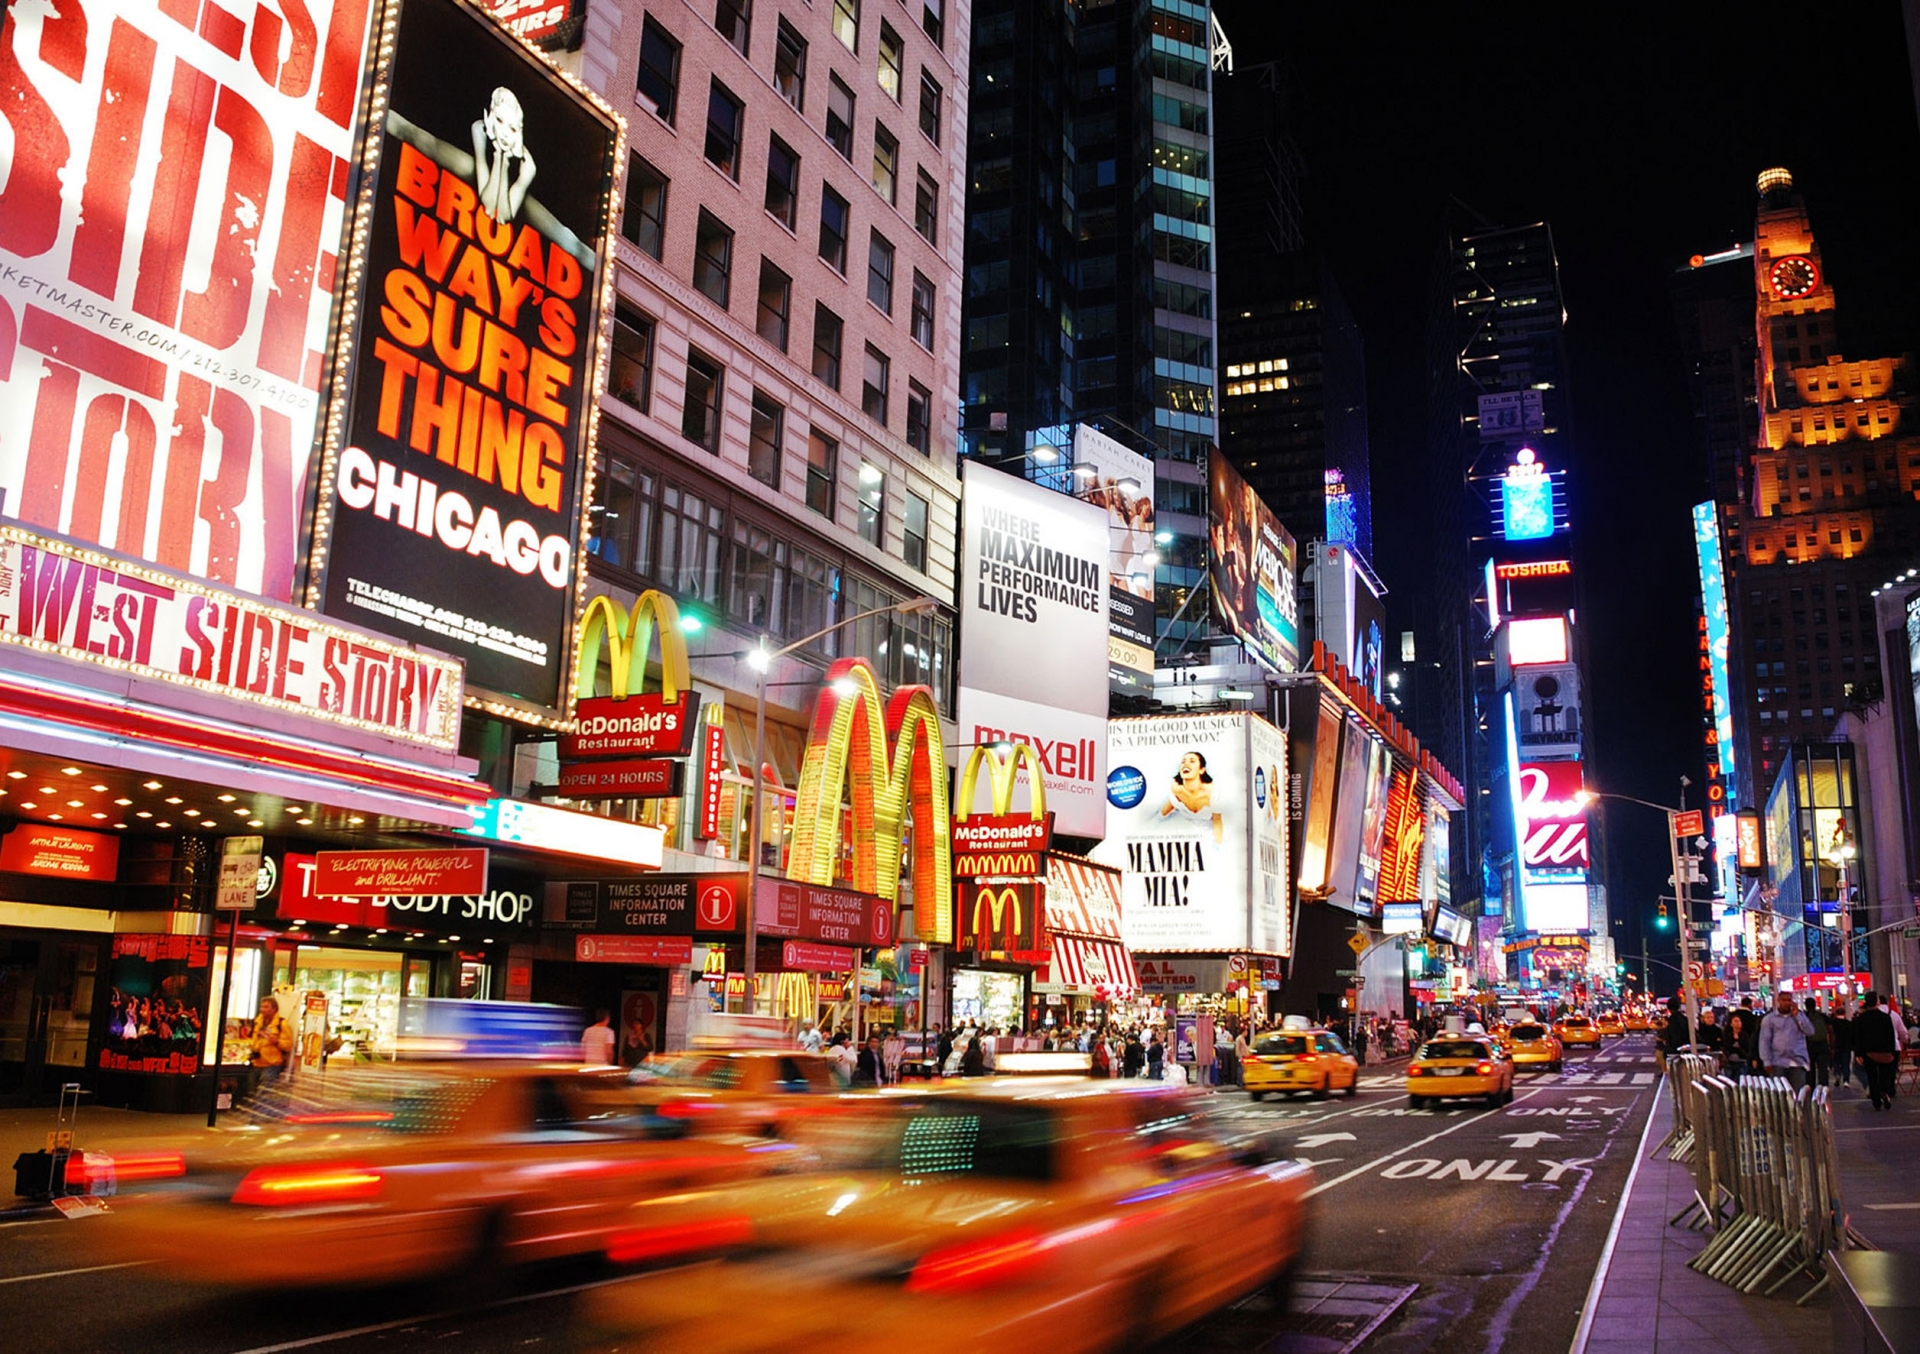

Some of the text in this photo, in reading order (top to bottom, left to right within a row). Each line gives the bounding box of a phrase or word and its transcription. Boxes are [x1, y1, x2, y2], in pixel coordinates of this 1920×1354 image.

[394, 141, 584, 301] BROAD
[393, 195, 578, 358] WAY'S
[380, 267, 573, 427] SURE
[1514, 393, 1538, 401] BCK
[373, 335, 567, 513] THING
[0, 290, 316, 605] TORY
[337, 446, 571, 590] CHICAGO
[981, 505, 1041, 543] WHERE
[980, 526, 1100, 592] MAXIMUM
[1500, 562, 1571, 578] TOSHIBA
[979, 558, 1100, 615] PERFORMANCE
[17, 543, 176, 668] WEST
[978, 580, 1037, 624] LIVES
[178, 594, 309, 706] SIDE
[1698, 615, 1715, 710] ERNST
[320, 635, 445, 738] STORY
[1126, 720, 1189, 735] FEEL-GOOD
[1192, 716, 1242, 731] MUSICAL
[578, 735, 656, 749] Restaurant
[711, 731, 721, 769] OPEN
[1520, 732, 1579, 745] CHEVROLET
[562, 771, 665, 786] OPEN 24 HOURS
[707, 784, 719, 832] HOURS
[1291, 773, 1303, 820] IS COMING
[955, 825, 1043, 840] McDonald's
[969, 840, 1028, 849] Restaurant
[410, 856, 473, 871] POWERFUL
[1126, 841, 1205, 873] MAMMA
[220, 877, 257, 889] SHARED
[354, 875, 373, 886] and
[608, 884, 689, 897] TIMES SQUARE
[1143, 875, 1189, 907] MIA!
[223, 891, 248, 903] LANE
[461, 890, 534, 924] SHOP
[609, 899, 686, 912] INFORMATION
[808, 891, 863, 912] TIMES SQUARE
[625, 913, 668, 926] CENTER
[808, 907, 862, 927] INFORMATION
[820, 925, 850, 941] CENTER
[1350, 1108, 1468, 1117] ONLY
[1506, 1106, 1628, 1116] ONLY
[1380, 1158, 1594, 1181] ONLY
